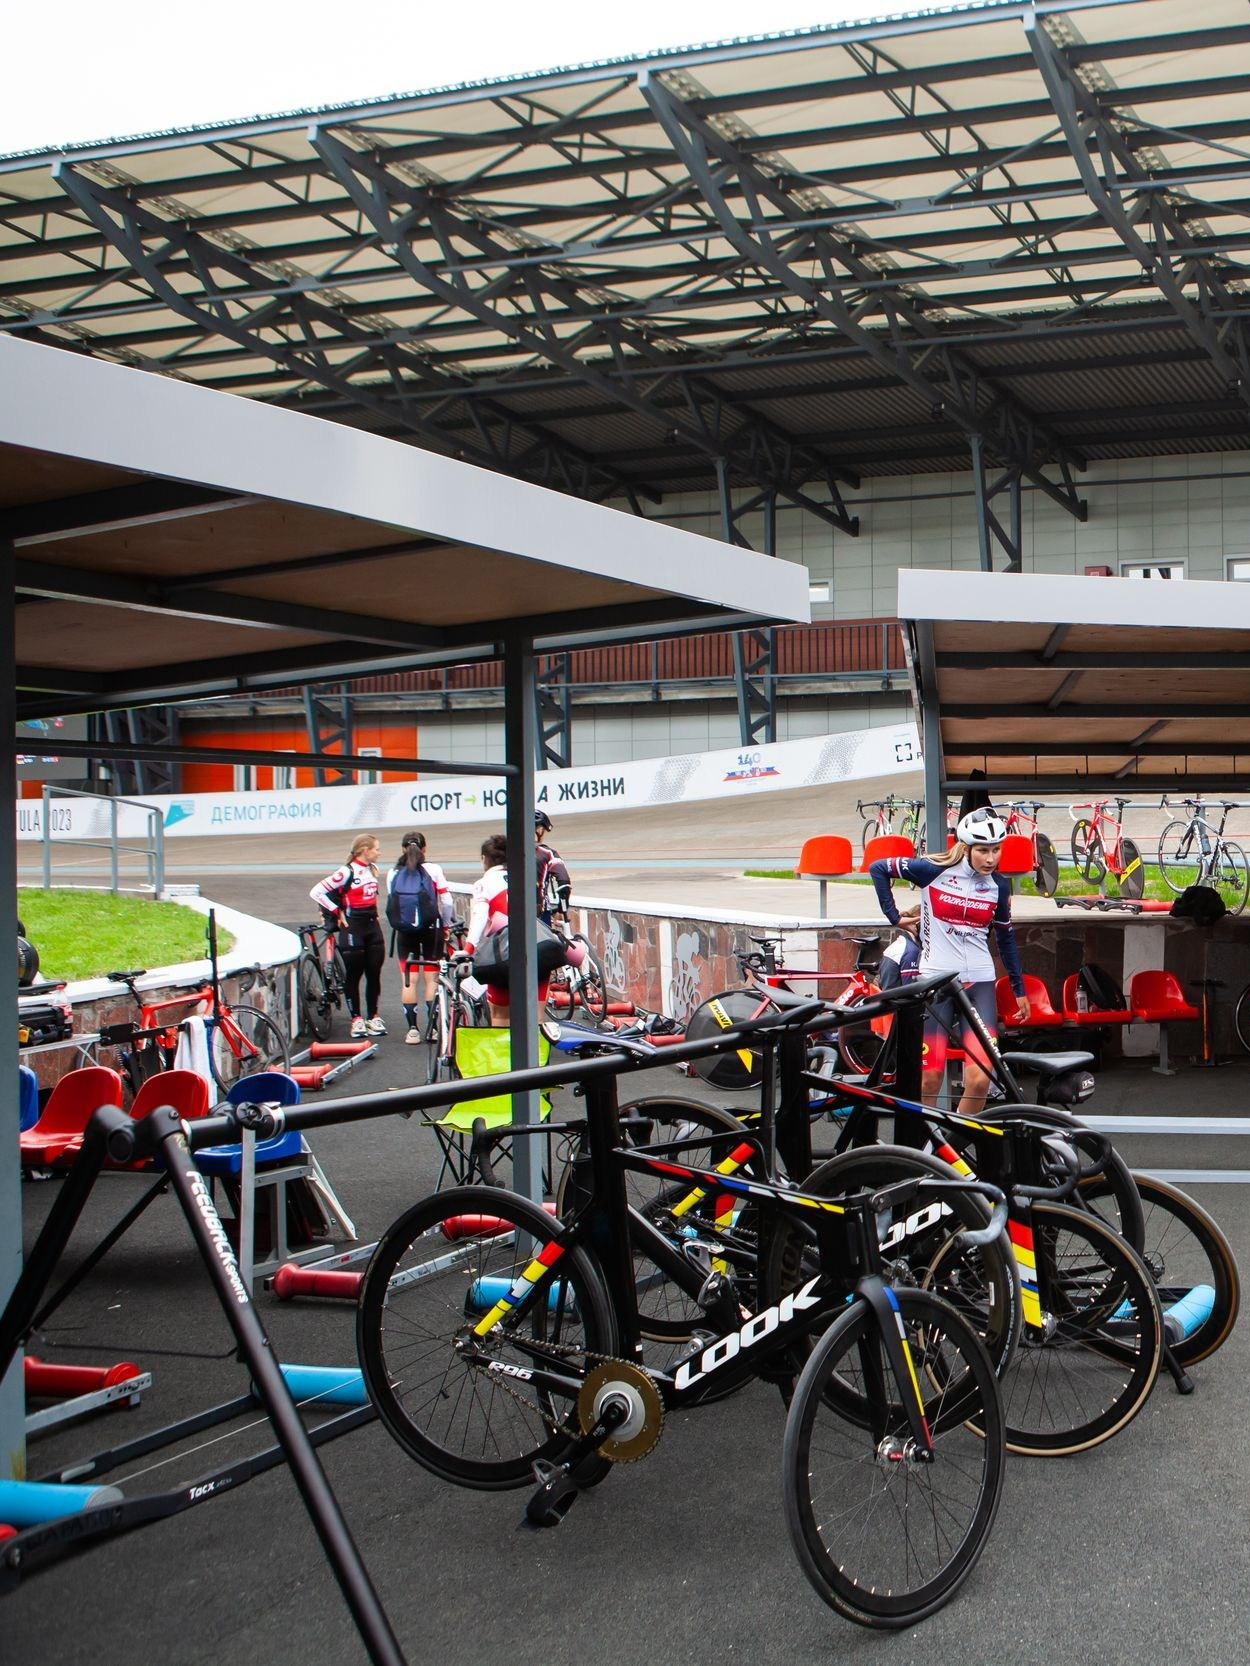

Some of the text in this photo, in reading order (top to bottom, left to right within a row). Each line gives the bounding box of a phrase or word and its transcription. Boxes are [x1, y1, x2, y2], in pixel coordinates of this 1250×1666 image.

[410, 777, 625, 812] СПОРТ НОА ЖИЗНИ
[16, 808, 72, 832] ULA 023
[211, 802, 322, 825] ДЕМОГРАФИЯ
[938, 893, 991, 911] VOZROZDENIE
[712, 1002, 731, 1027] MAVI
[186, 1171, 249, 1304] FEEDBACK SPORTS
[675, 1273, 823, 1390] LOOK
[487, 1360, 534, 1381] R96
[189, 1481, 215, 1501] Tacx
